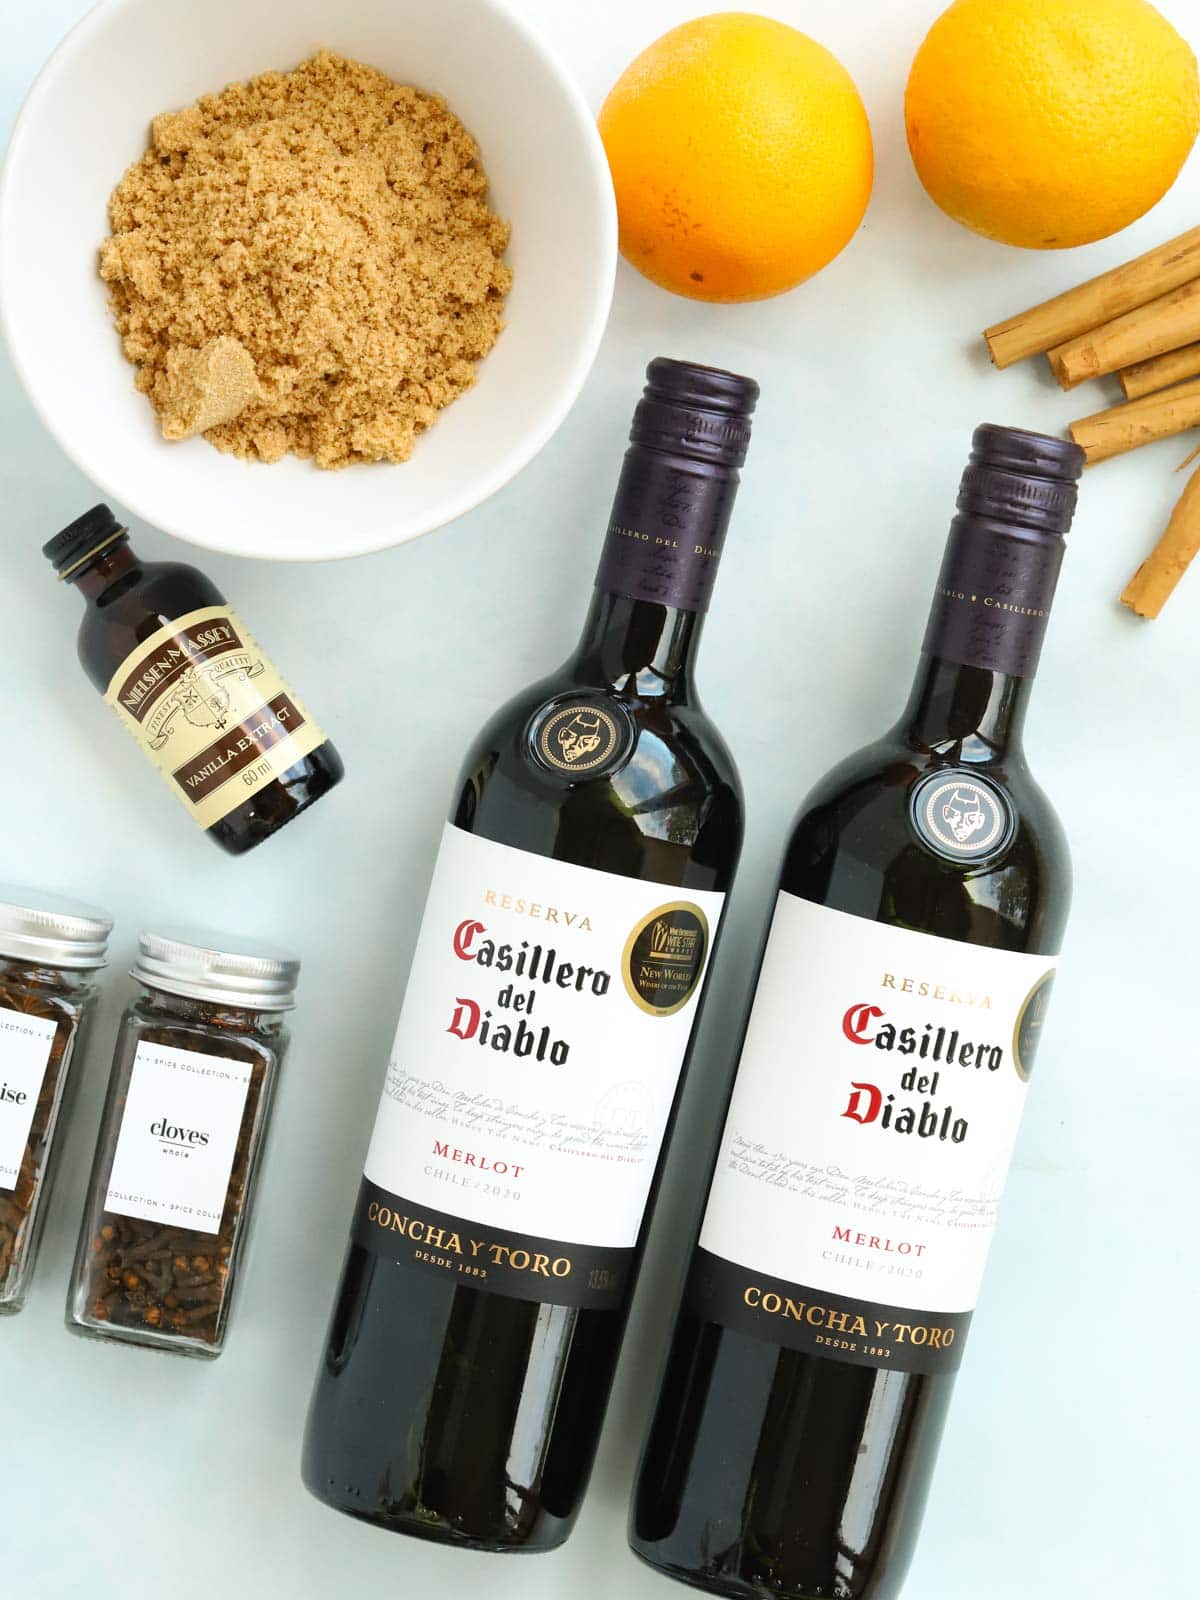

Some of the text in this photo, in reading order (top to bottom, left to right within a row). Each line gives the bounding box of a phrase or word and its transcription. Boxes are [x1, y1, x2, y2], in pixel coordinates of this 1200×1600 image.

[655, 537, 679, 548] DEL
[185, 706, 291, 789] VANILLA EXTRACT
[242, 758, 272, 786] 60 ml
[483, 889, 593, 932] RESERVA
[453, 919, 611, 997] Casillero
[639, 966, 663, 979] NEW
[497, 983, 536, 1015] del
[881, 972, 993, 1009] RESERVA
[446, 996, 570, 1066] Diablo
[842, 1002, 1003, 1072] Casillero
[154, 1058, 177, 1069] SPICE
[180, 1064, 230, 1080] COLLECTION
[900, 1066, 939, 1096] del
[840, 1081, 968, 1144] Diablo
[150, 1117, 210, 1146] cloves
[162, 1148, 190, 1159] whole
[431, 1140, 525, 1179] MERLOT
[108, 1189, 158, 1207] COLLECTION
[170, 1203, 194, 1214] SPICE
[368, 1201, 572, 1278] CONCHA Y TORO
[831, 1225, 928, 1258] MERLOT
[415, 1250, 488, 1279] DESDE 1883
[743, 1286, 955, 1350] CONCHA Y TORO
[815, 1335, 891, 1358] DESDE 1883
